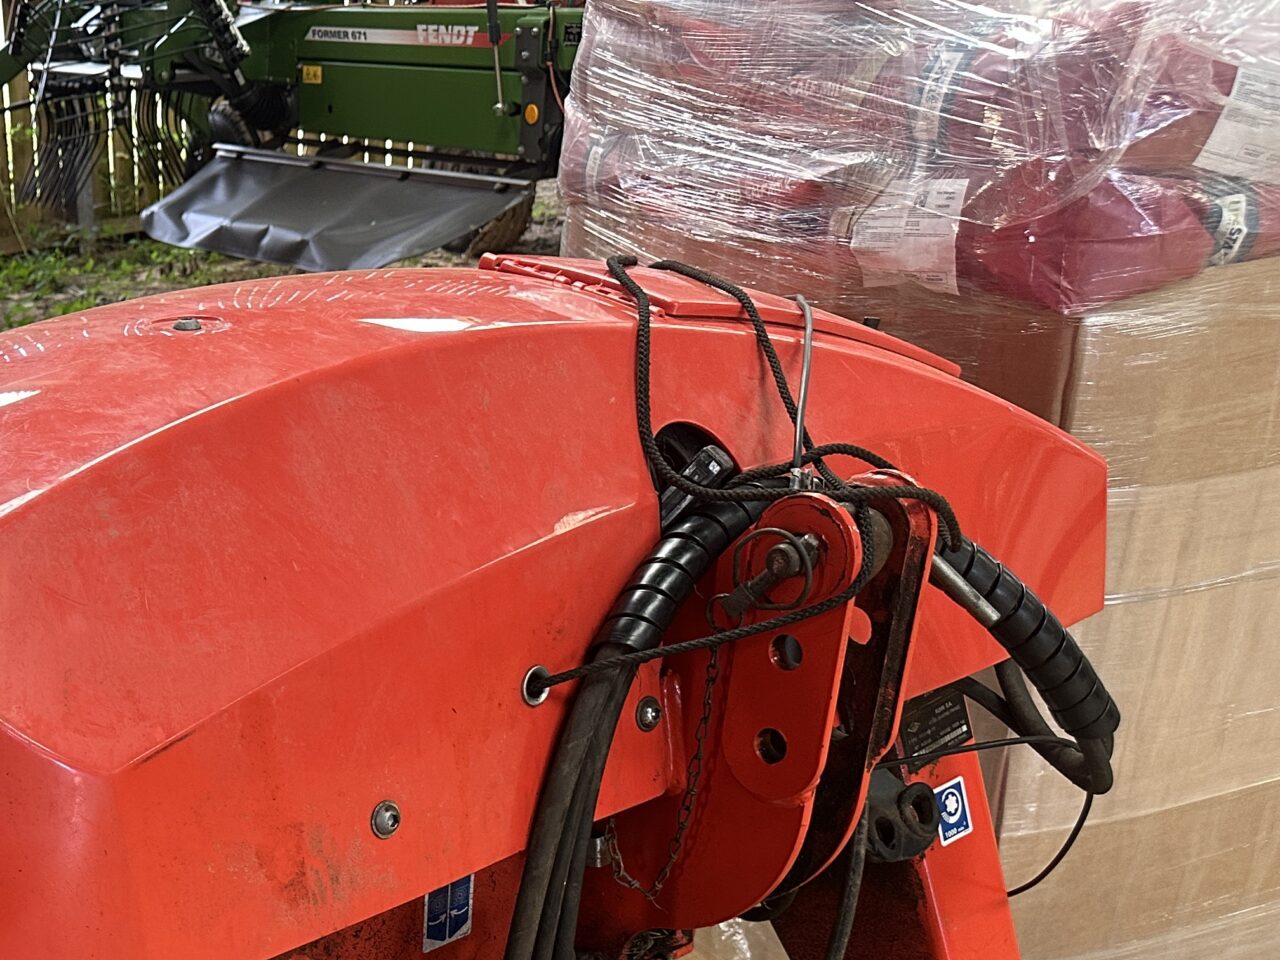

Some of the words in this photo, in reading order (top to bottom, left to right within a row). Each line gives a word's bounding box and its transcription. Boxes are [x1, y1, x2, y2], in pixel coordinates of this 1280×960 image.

[311, 28, 350, 41] FORMER
[351, 30, 368, 41] 671
[416, 24, 479, 45] FENDT
